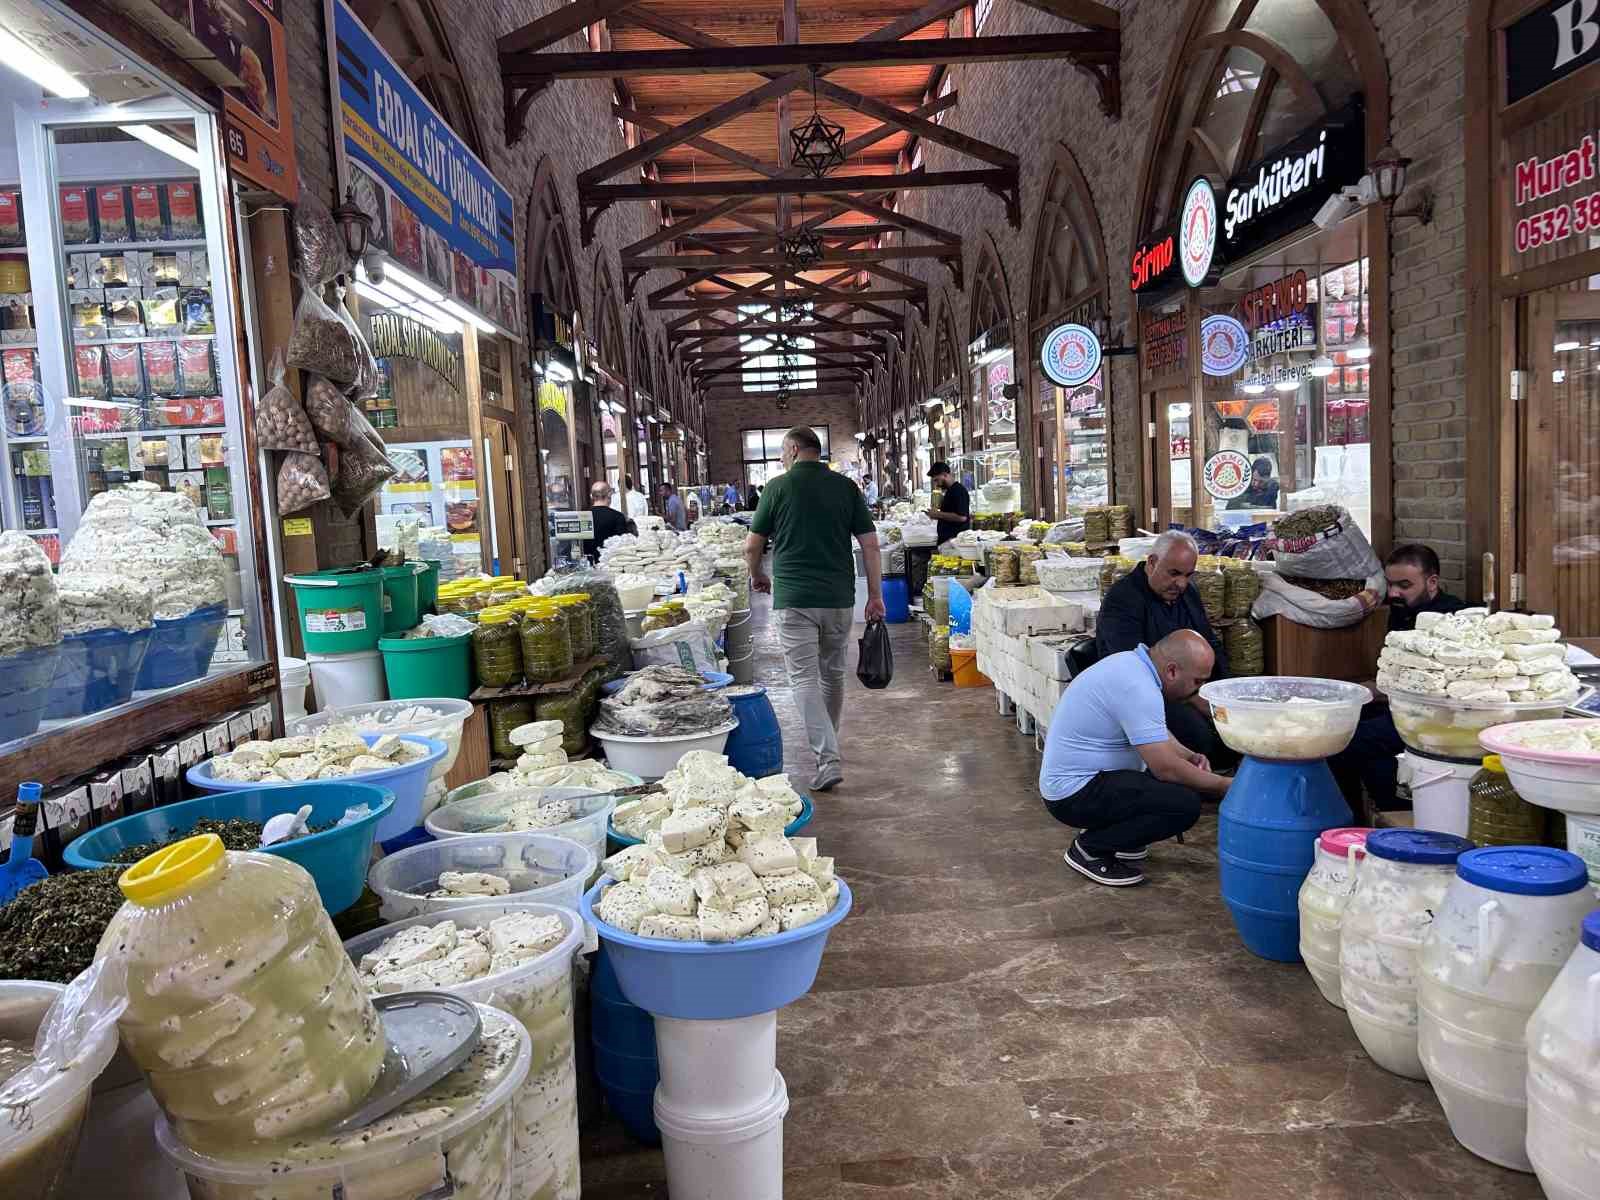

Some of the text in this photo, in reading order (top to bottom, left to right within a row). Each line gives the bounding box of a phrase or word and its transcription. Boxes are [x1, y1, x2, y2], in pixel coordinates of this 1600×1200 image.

[229, 128, 244, 156] 65
[374, 69, 423, 168] ERDAL
[423, 118, 447, 192] SÜT
[448, 140, 498, 240] ÜRÜNLERİ
[1515, 135, 1594, 206] Murat
[1224, 130, 1326, 239] Şarküteri
[1515, 192, 1600, 252] 0532 38
[1131, 236, 1173, 290] Sirmo
[369, 313, 403, 359] ERDAL
